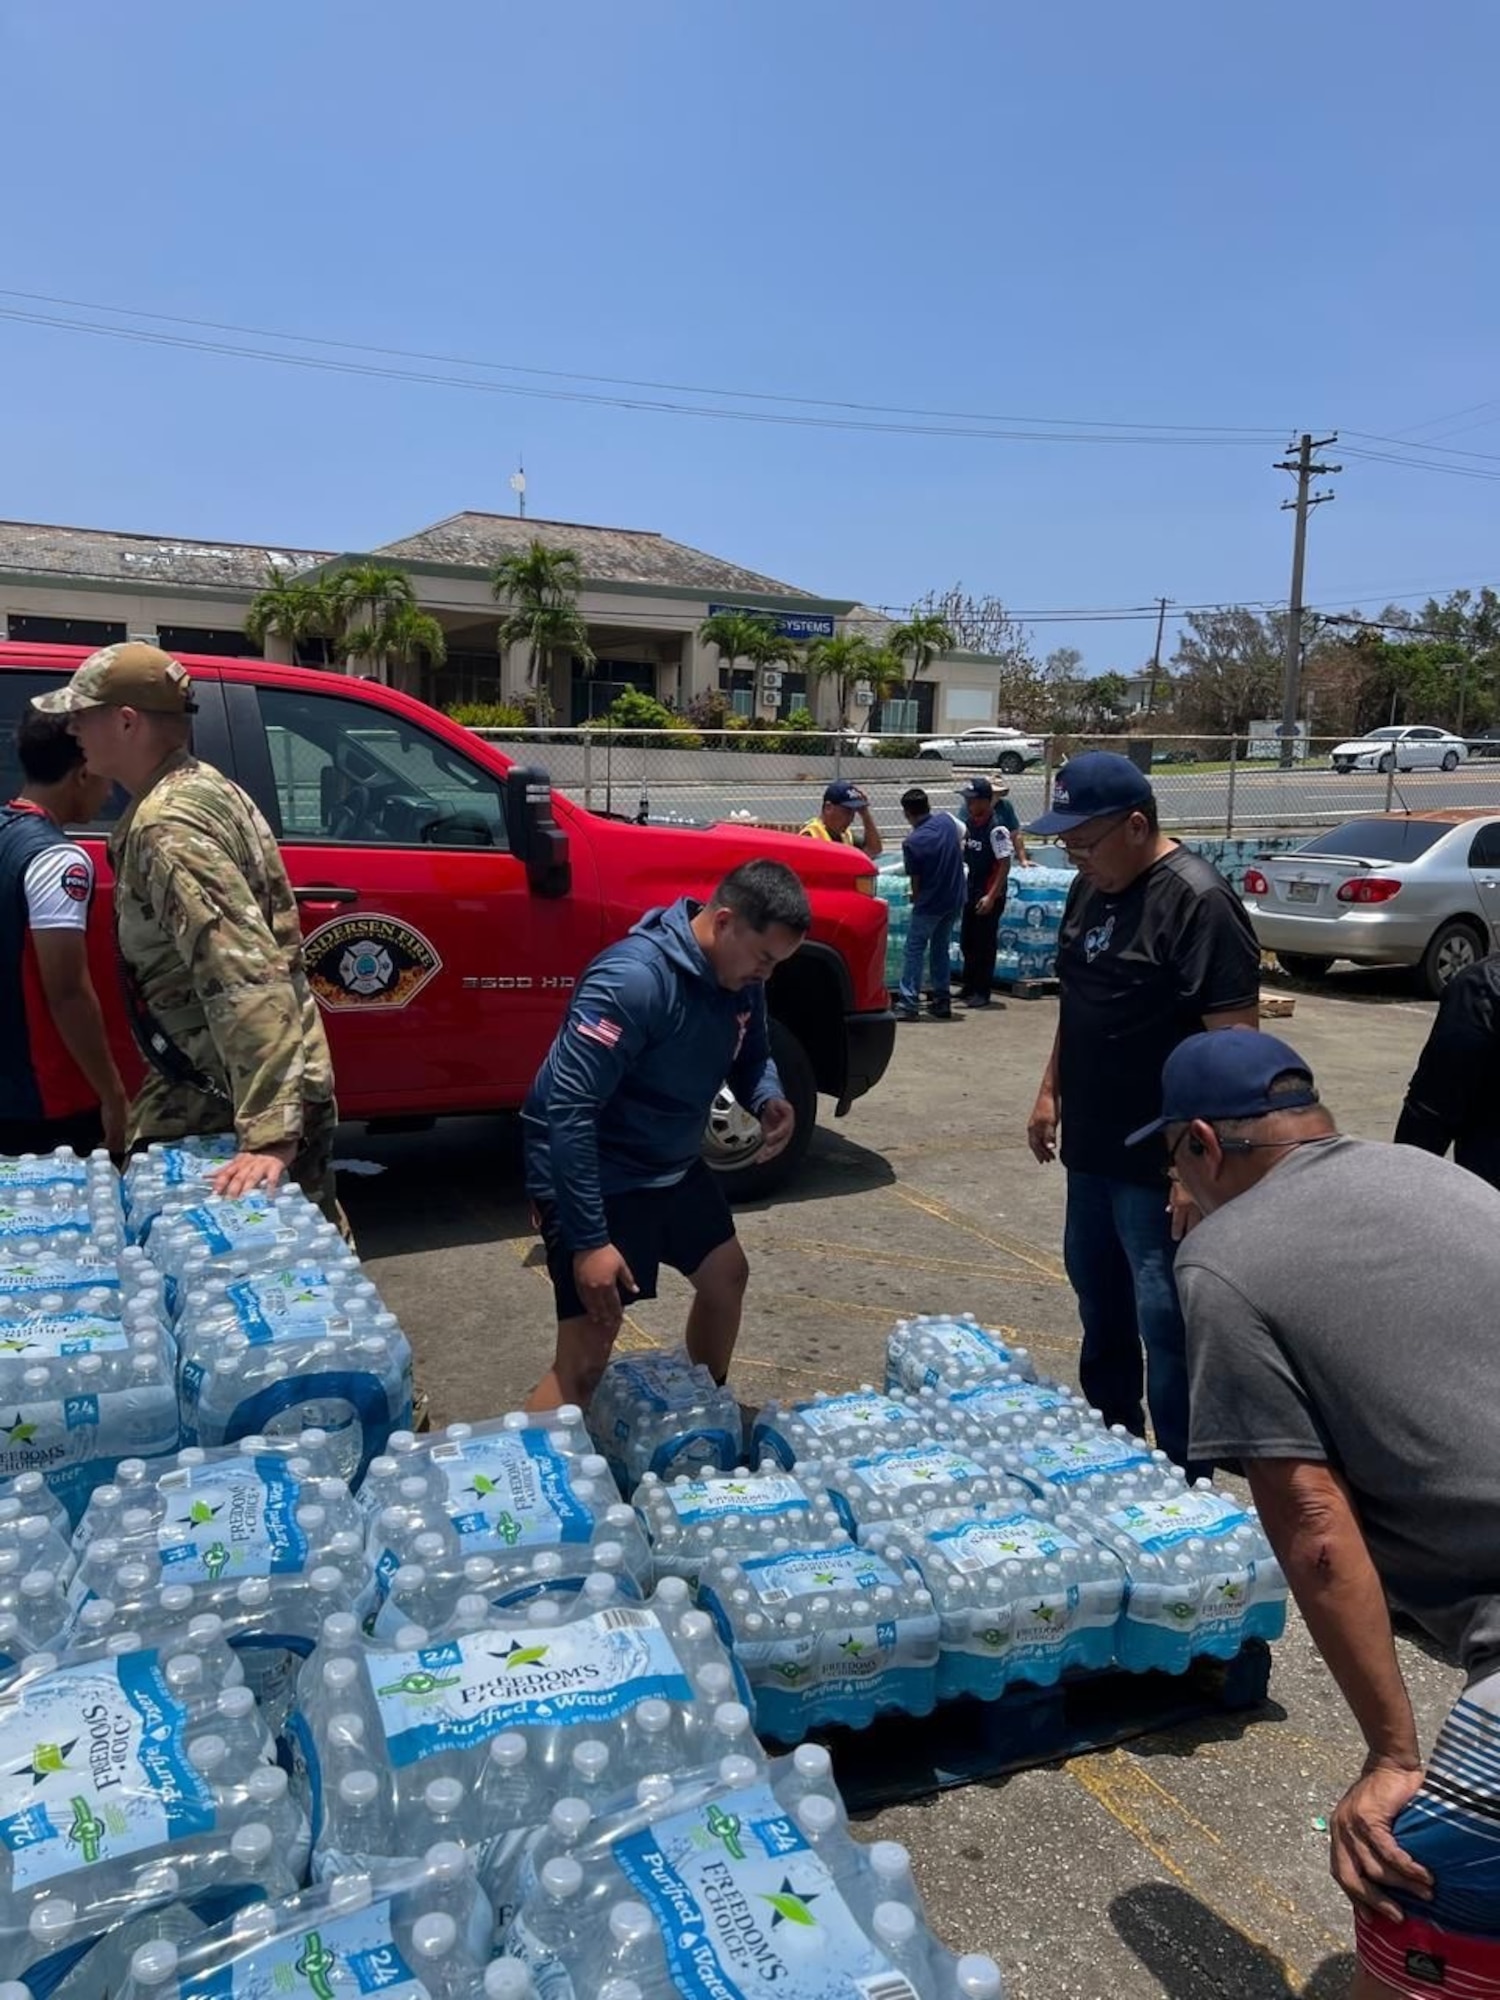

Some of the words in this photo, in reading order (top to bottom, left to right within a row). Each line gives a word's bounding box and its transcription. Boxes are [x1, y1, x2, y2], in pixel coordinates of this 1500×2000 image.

[397, 930, 433, 968] FIRE
[462, 976, 532, 989] 3500
[541, 976, 576, 989] HD
[68, 1402, 96, 1416] 24
[424, 1648, 456, 1663] 24
[488, 1679, 575, 1700] CHOICE
[437, 1702, 528, 1737] Purified
[553, 1689, 620, 1710] Water
[6, 1810, 34, 1846] 24
[769, 1820, 799, 1852] 24
[641, 1852, 702, 1928] Purified
[701, 1860, 789, 1983] FREEDOM'S
[702, 1881, 744, 1962] CHOICE
[369, 1950, 400, 1986] 24
